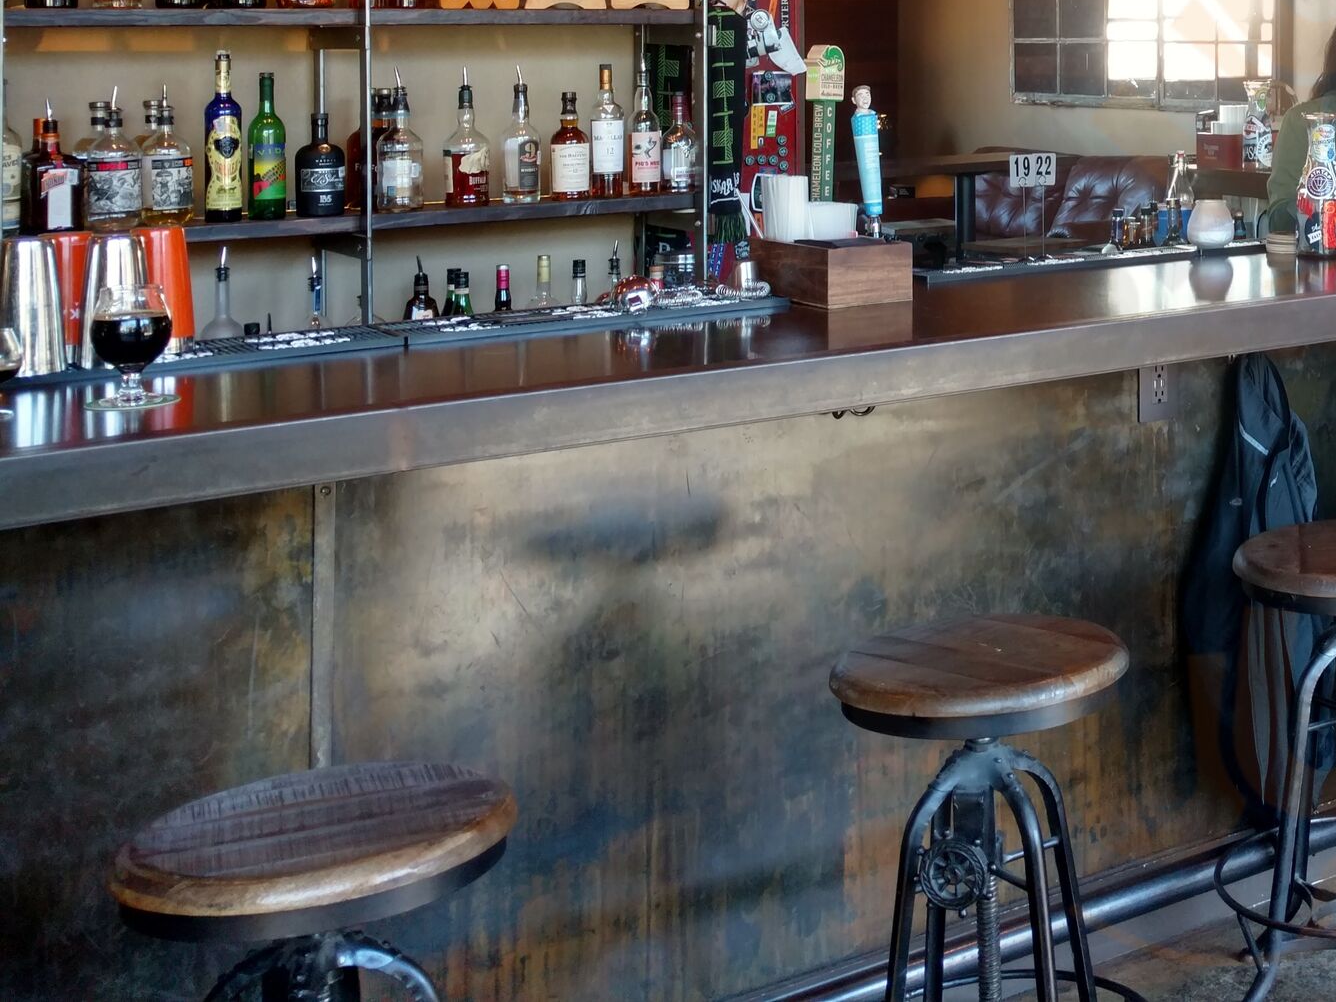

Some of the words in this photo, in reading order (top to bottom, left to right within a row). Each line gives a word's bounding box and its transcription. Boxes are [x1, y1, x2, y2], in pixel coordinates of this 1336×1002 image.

[824, 106, 833, 197] COFFEE
[1013, 155, 1031, 177] 19
[1035, 155, 1052, 176] 22
